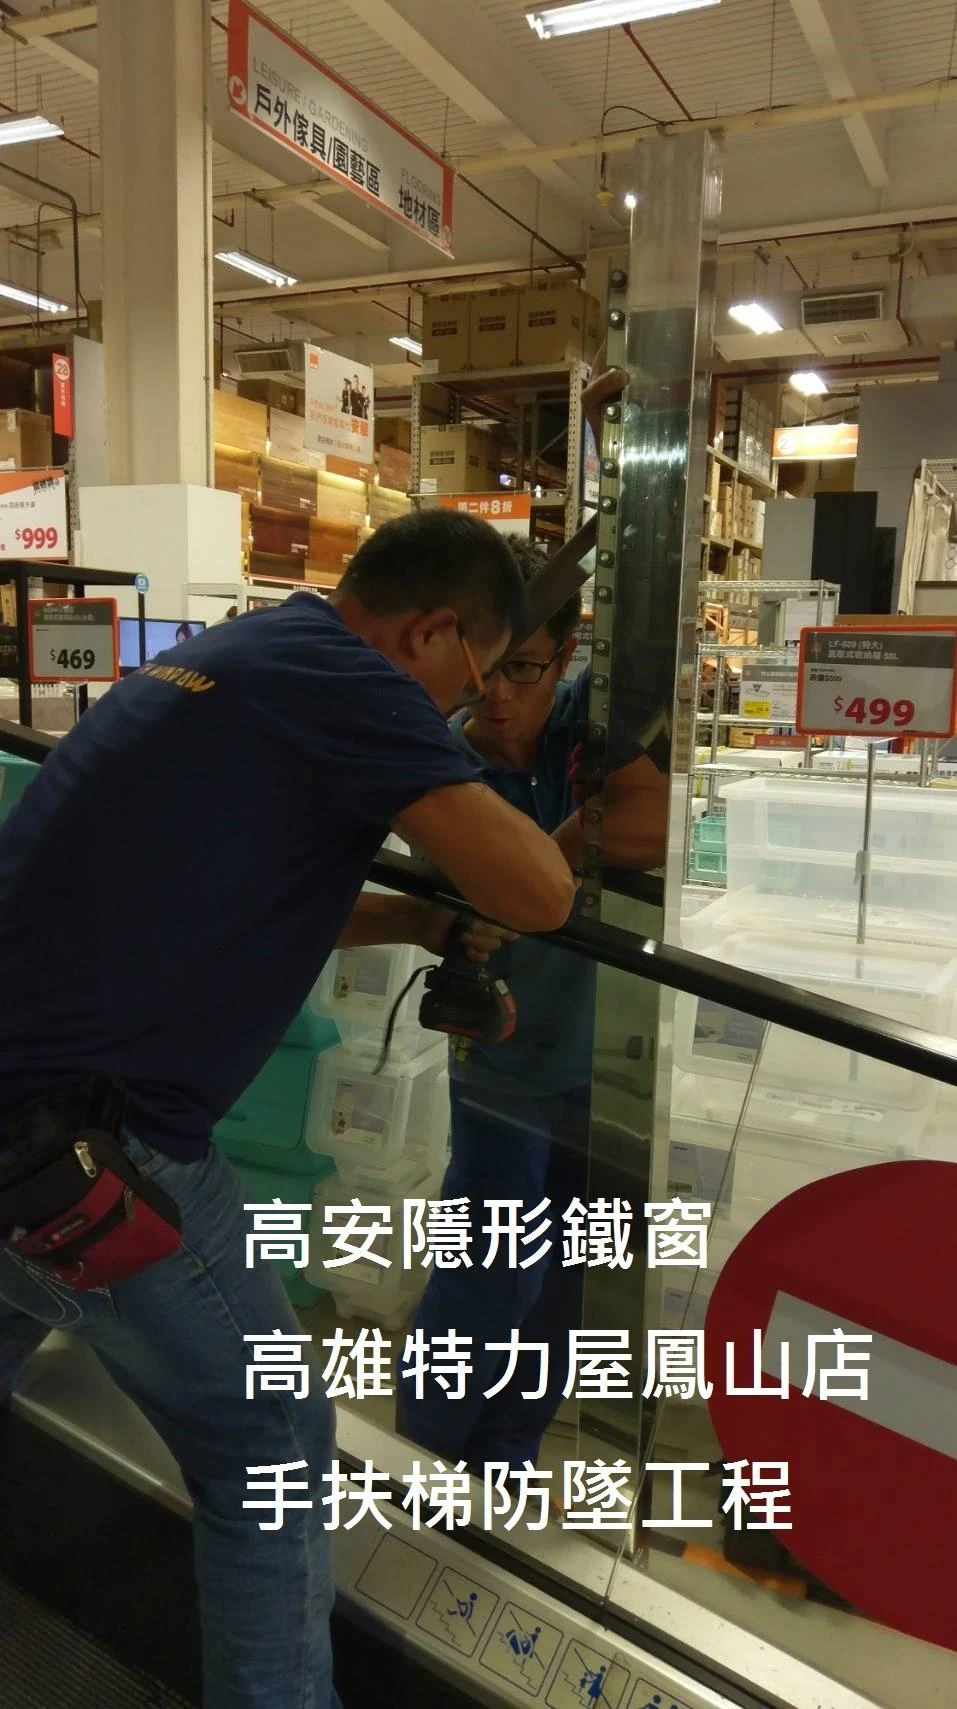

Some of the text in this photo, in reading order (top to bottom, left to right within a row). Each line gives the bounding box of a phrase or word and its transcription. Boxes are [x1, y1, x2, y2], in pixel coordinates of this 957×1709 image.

[252, 57, 302, 102] LEISURE
[308, 100, 370, 153] GARDENING
[398, 184, 441, 237] 地材區
[56, 360, 70, 377] 28
[15, 527, 58, 550] $999
[49, 648, 96, 670] $469
[833, 695, 916, 728] $499
